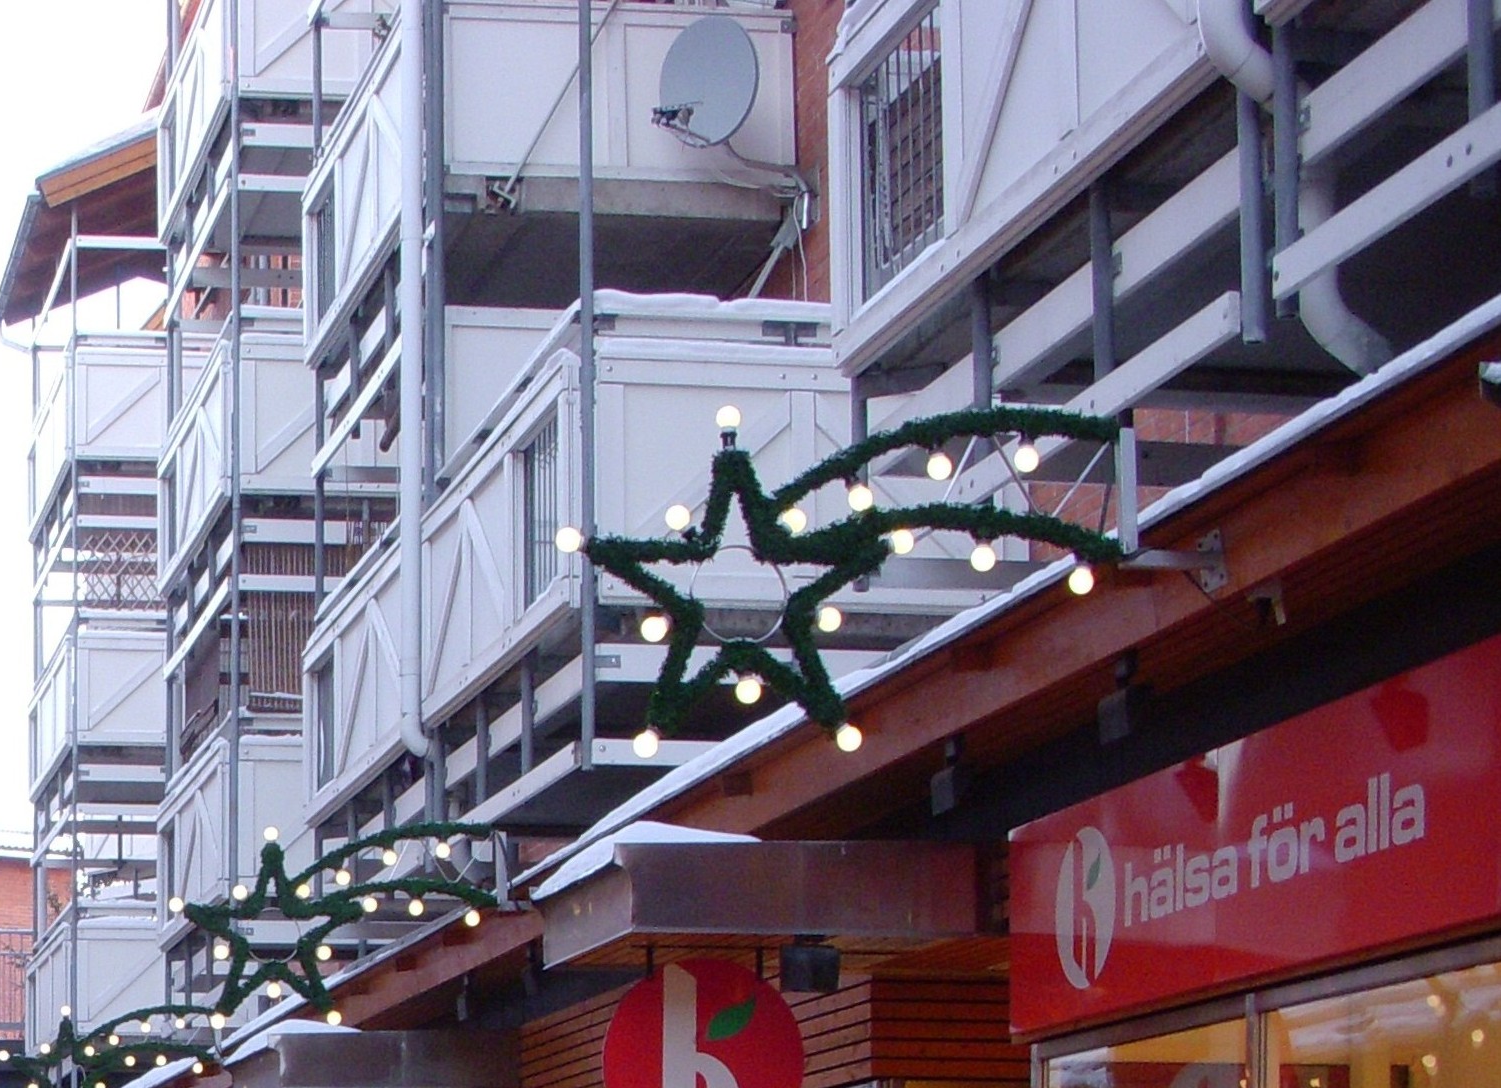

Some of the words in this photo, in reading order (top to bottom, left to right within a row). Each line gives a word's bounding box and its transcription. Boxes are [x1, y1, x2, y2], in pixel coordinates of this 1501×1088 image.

[1123, 843, 1238, 928] hälsa
[1246, 801, 1325, 889] för
[1333, 772, 1425, 863] alla
